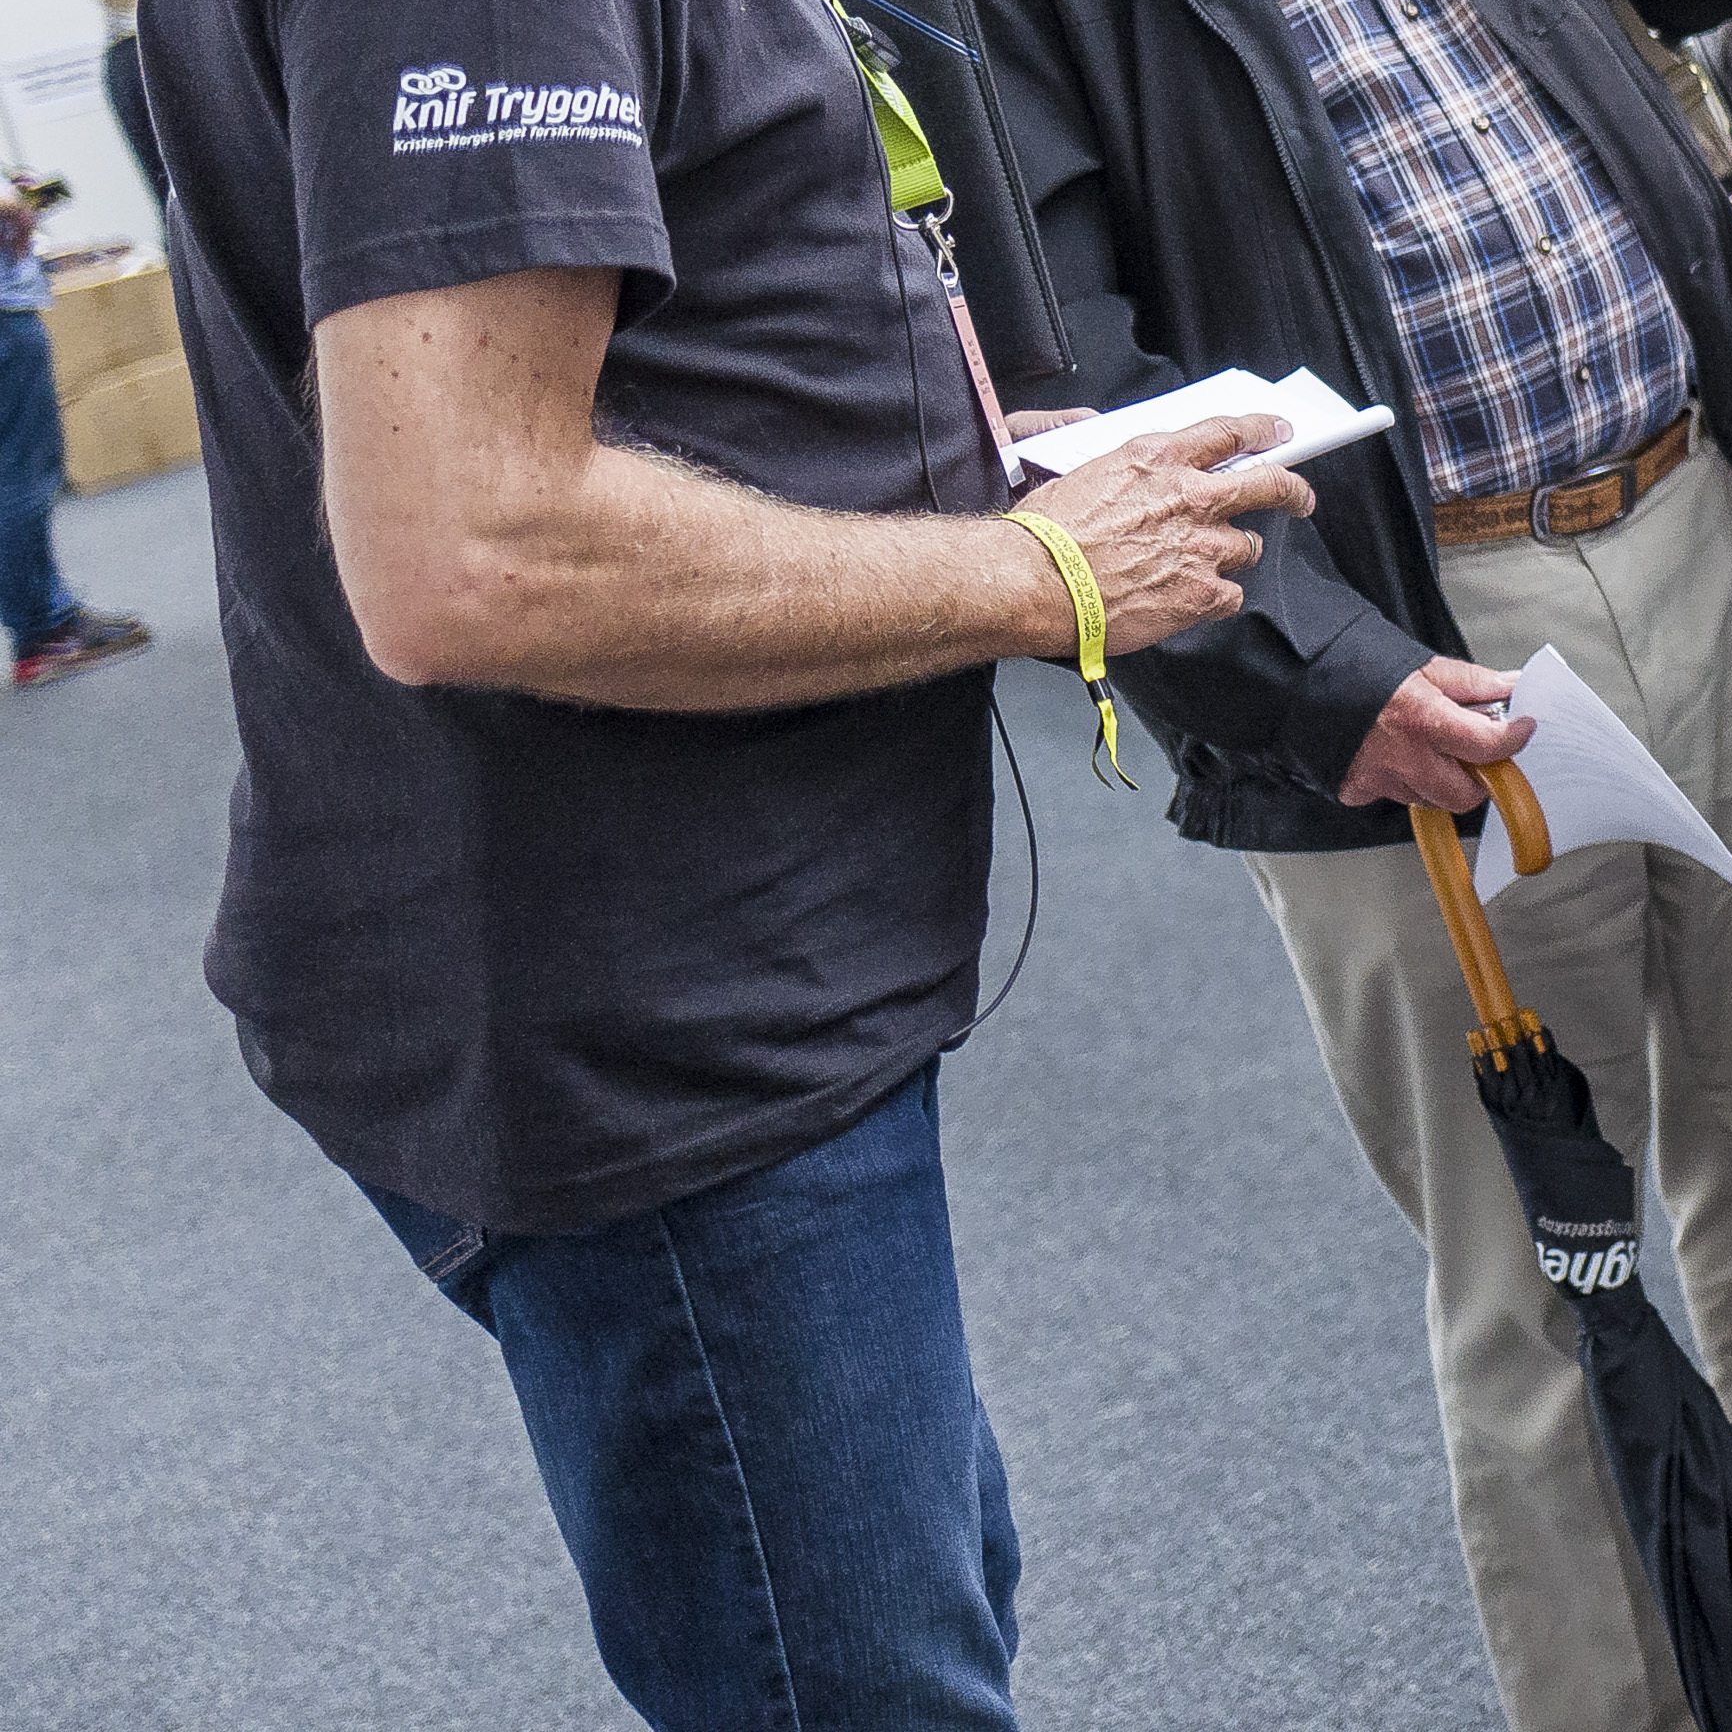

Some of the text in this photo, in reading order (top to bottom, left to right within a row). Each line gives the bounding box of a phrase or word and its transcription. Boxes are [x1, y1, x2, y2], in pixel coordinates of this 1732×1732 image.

[485, 84, 643, 128] Trygghet
[392, 132, 496, 153] Kristen-Norges
[498, 125, 527, 142] eget
